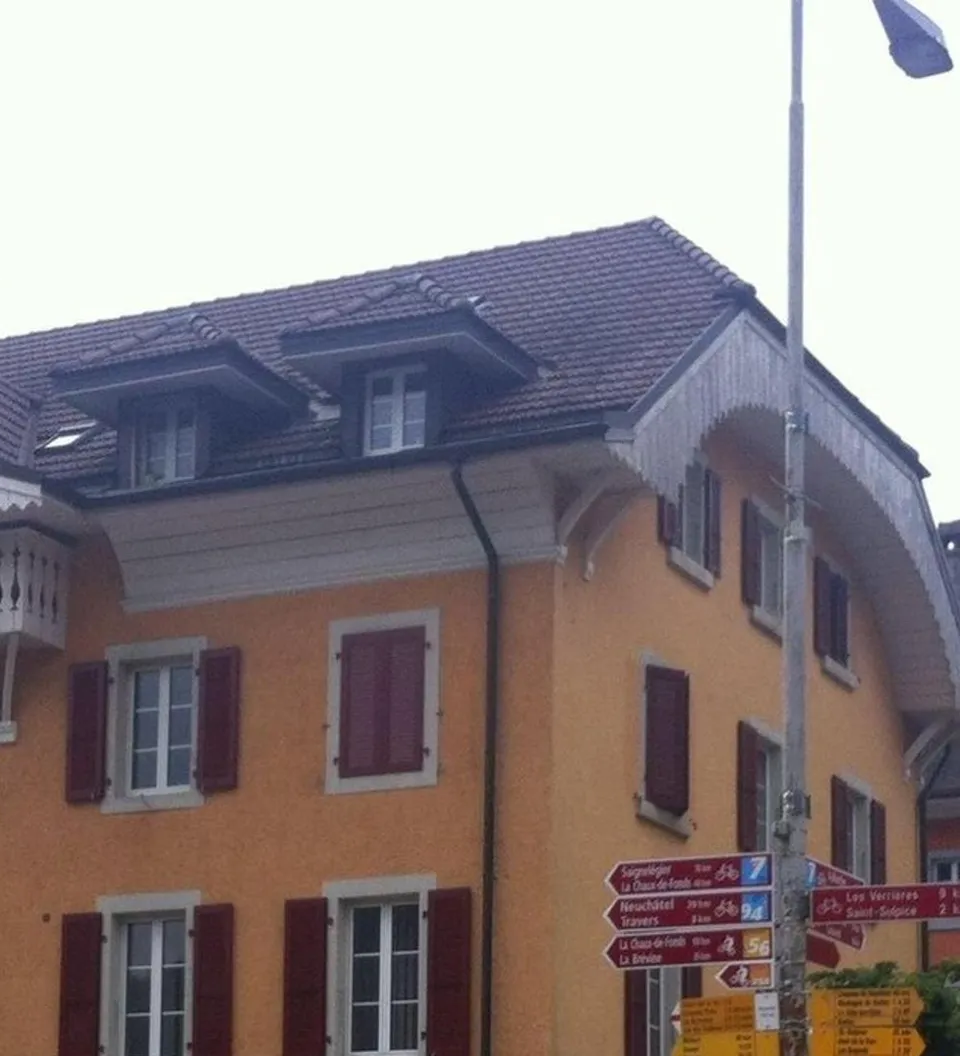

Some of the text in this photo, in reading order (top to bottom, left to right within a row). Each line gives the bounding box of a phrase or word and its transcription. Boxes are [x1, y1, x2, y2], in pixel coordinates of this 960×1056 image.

[749, 857, 767, 880] 7
[620, 898, 674, 913] Neuchâtel
[939, 903, 948, 915] 2
[620, 915, 660, 928] Travers
[749, 937, 770, 957] 56
